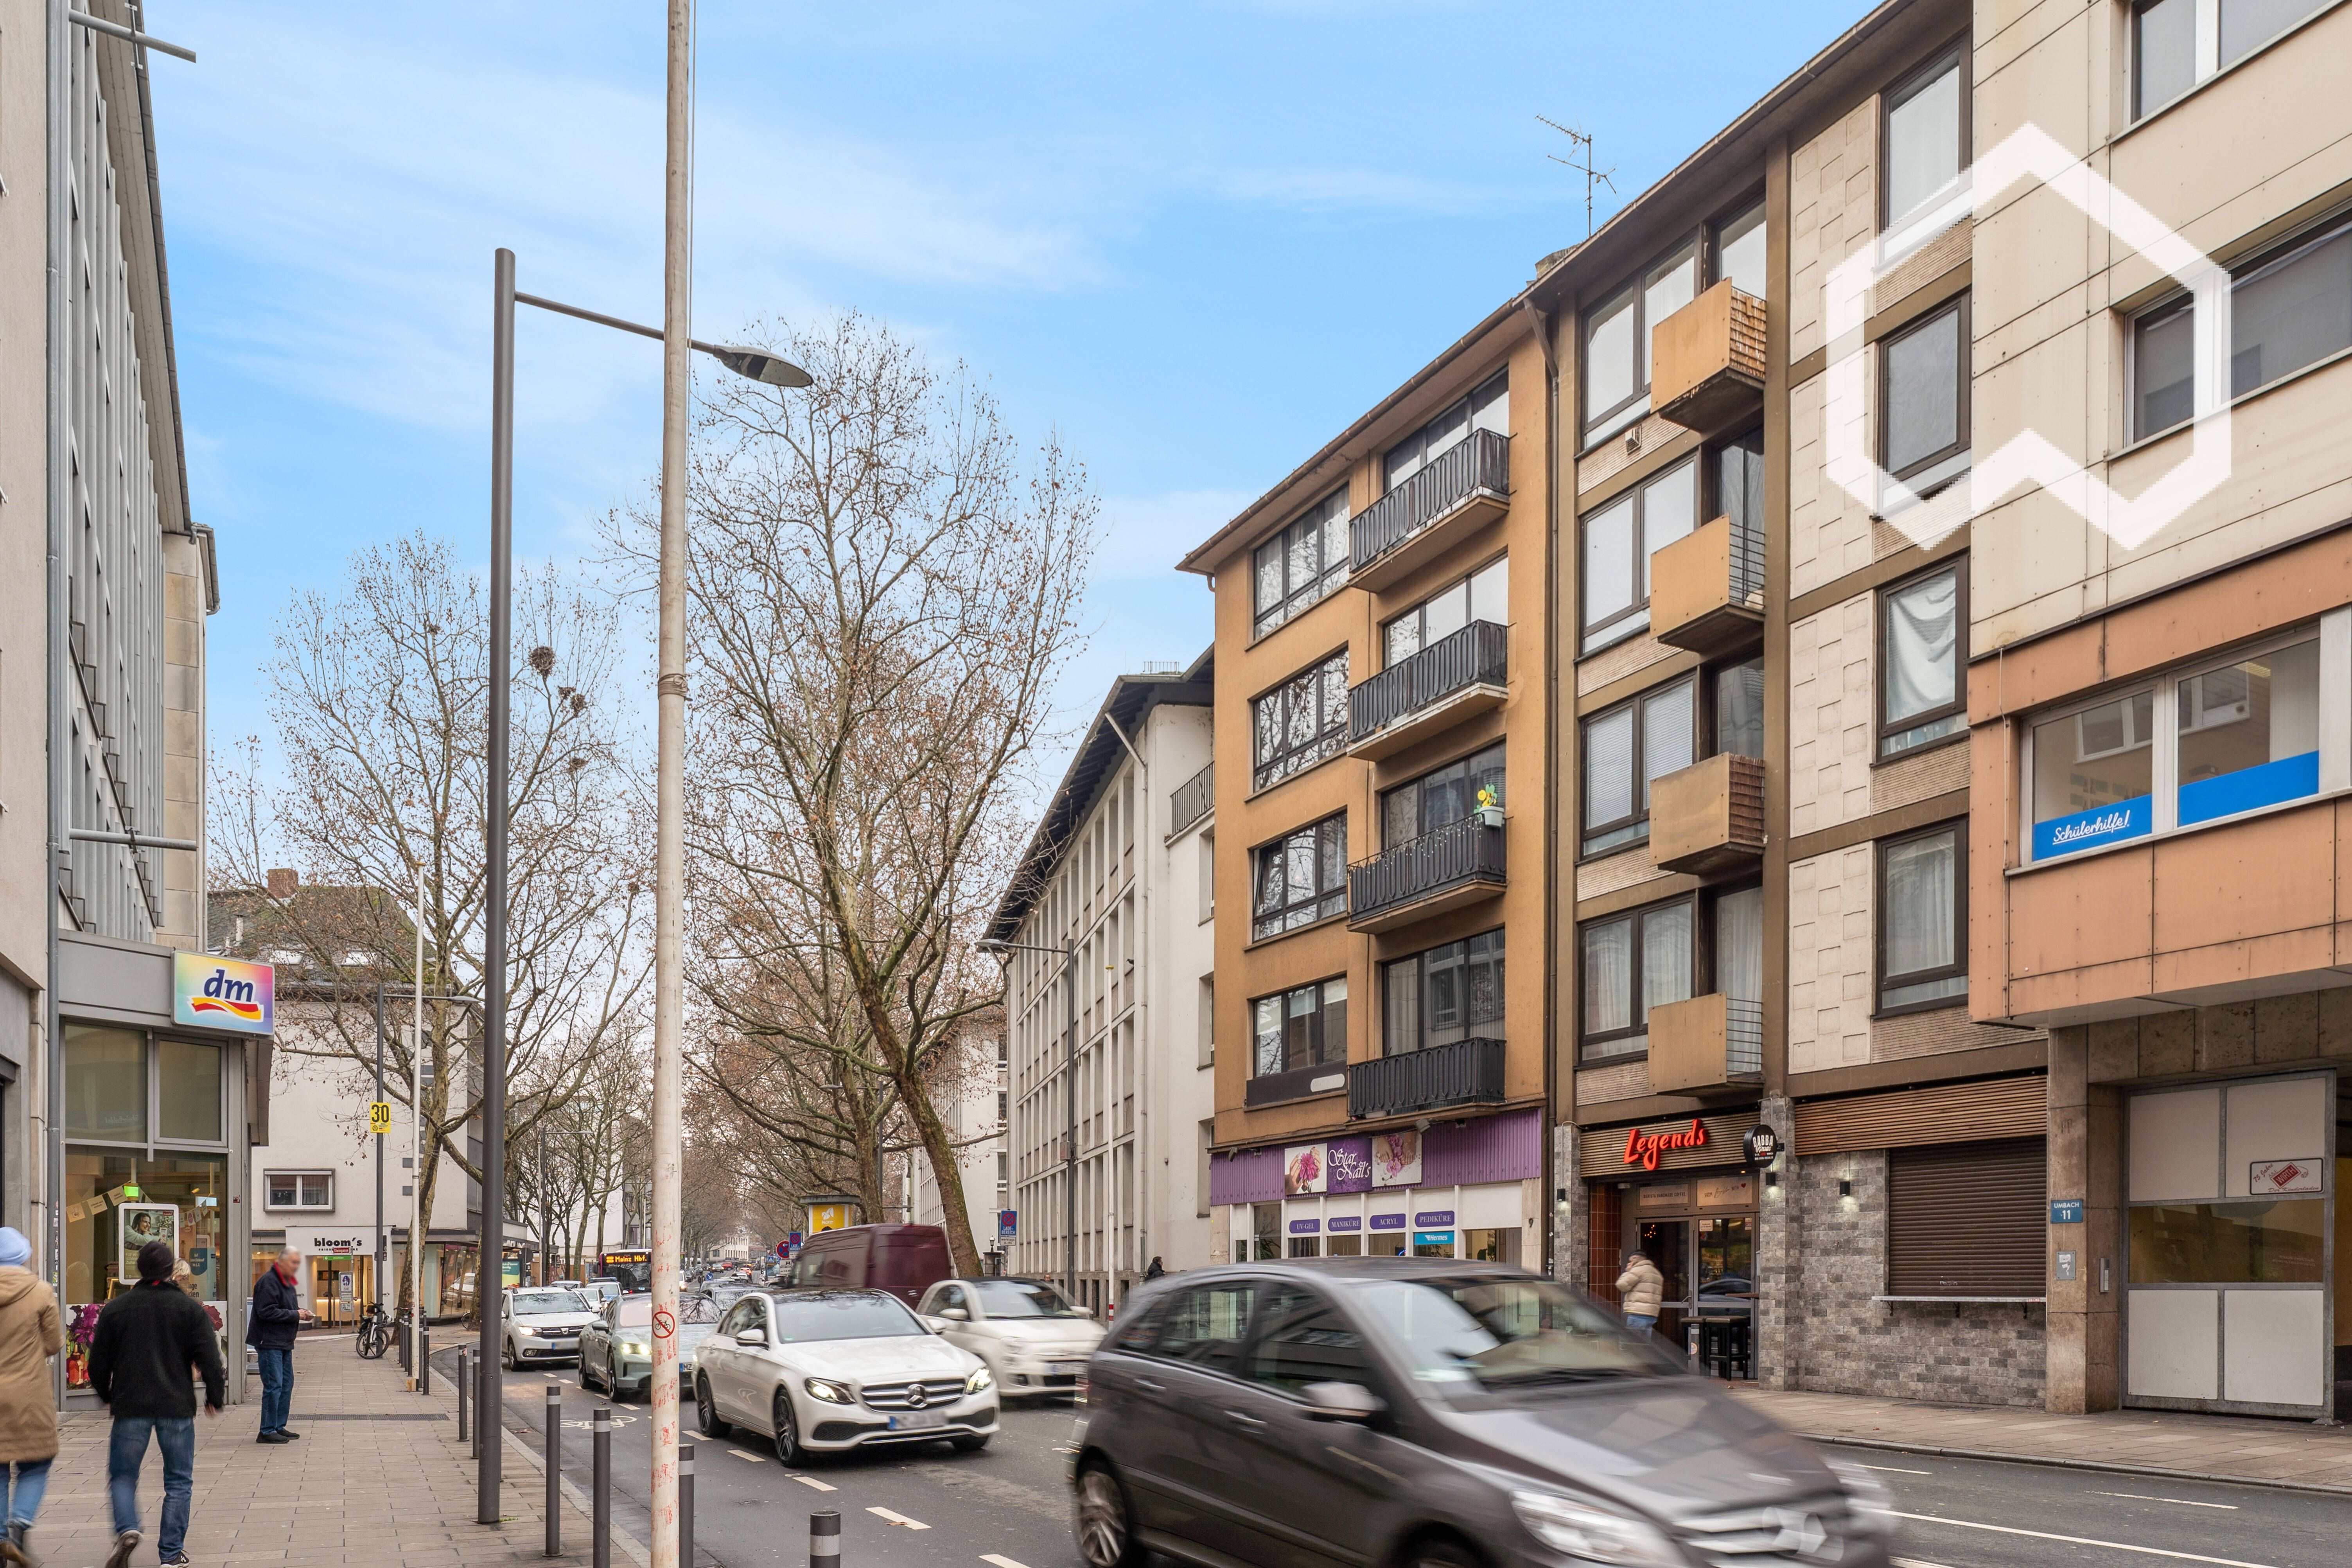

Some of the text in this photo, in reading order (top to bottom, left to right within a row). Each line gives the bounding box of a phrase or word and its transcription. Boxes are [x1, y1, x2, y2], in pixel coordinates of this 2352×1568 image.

[2053, 810, 2130, 842] Schülerhilfe!
[204, 969, 253, 1002] dm
[372, 1104, 389, 1123] 30
[1624, 1119, 1707, 1171] Legends
[1752, 1135, 1774, 1147] BABBA
[1329, 1148, 1357, 1166] Star
[2253, 1163, 2273, 1183] 75 Jahre
[2276, 1167, 2297, 1184] WIRTH
[1331, 1219, 1360, 1228] MANIKÜRE
[1420, 1214, 1451, 1223] PEDIKÜRE
[2062, 1210, 2070, 1220] 11
[314, 1238, 362, 1246] bloom's
